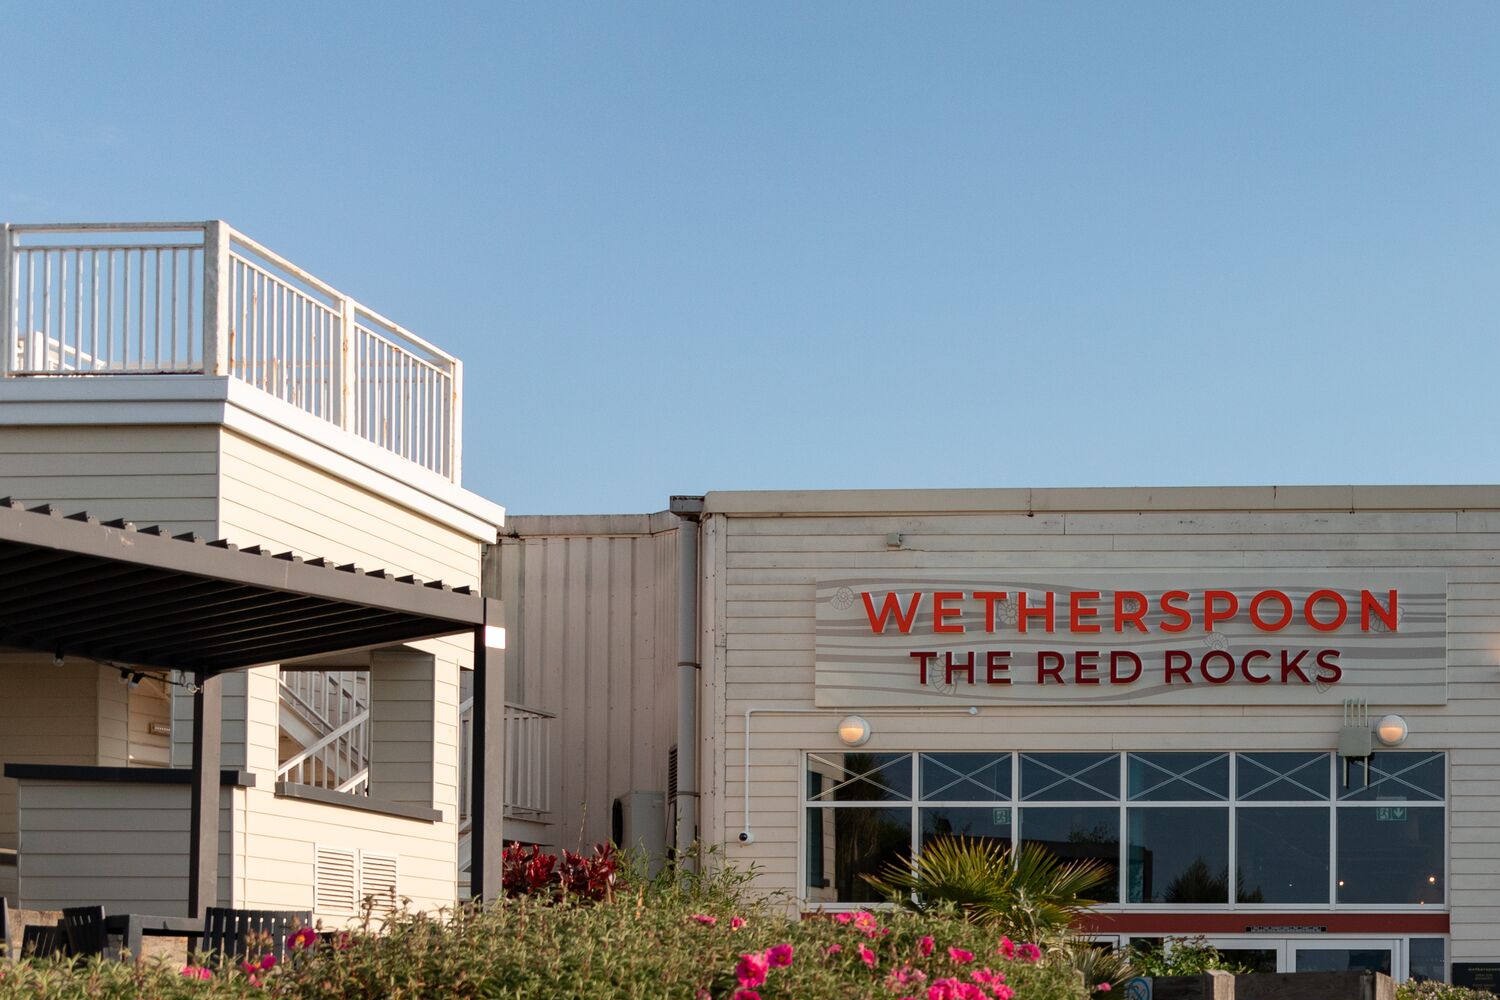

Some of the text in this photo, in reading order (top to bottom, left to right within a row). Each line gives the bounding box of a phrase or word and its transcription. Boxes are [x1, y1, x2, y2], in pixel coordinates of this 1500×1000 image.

[860, 588, 1399, 635] WETHERSPOON
[910, 649, 1342, 685] THE RED ROCKS
